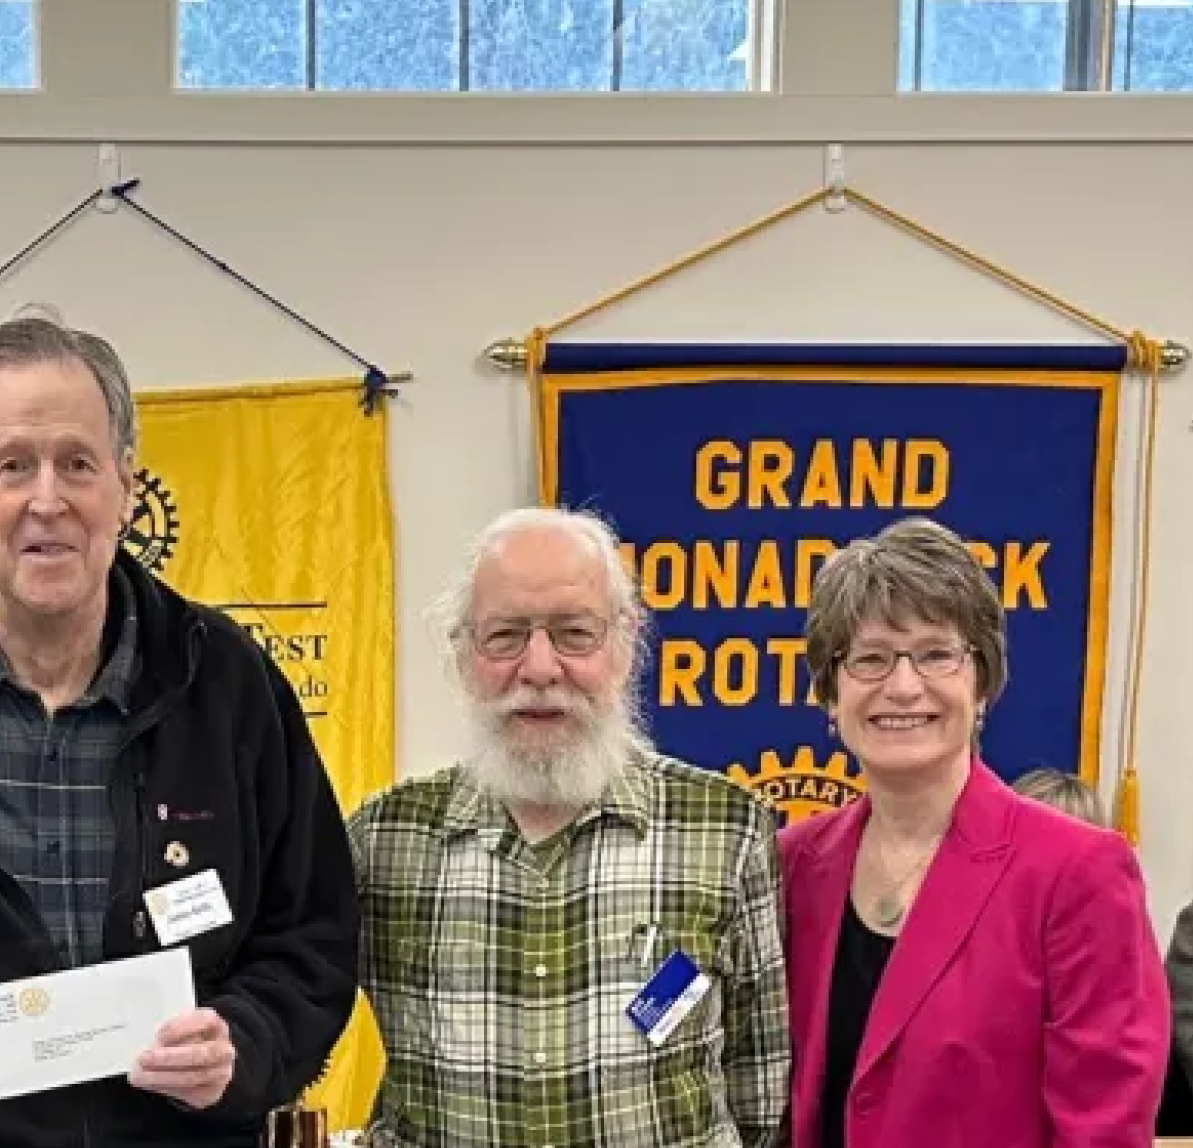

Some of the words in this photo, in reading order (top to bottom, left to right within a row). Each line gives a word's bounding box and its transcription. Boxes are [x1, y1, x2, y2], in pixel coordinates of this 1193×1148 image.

[696, 438, 949, 509] GRAND
[298, 675, 328, 698] do
[659, 637, 820, 707] ROT
[756, 778, 859, 811] OTARY
